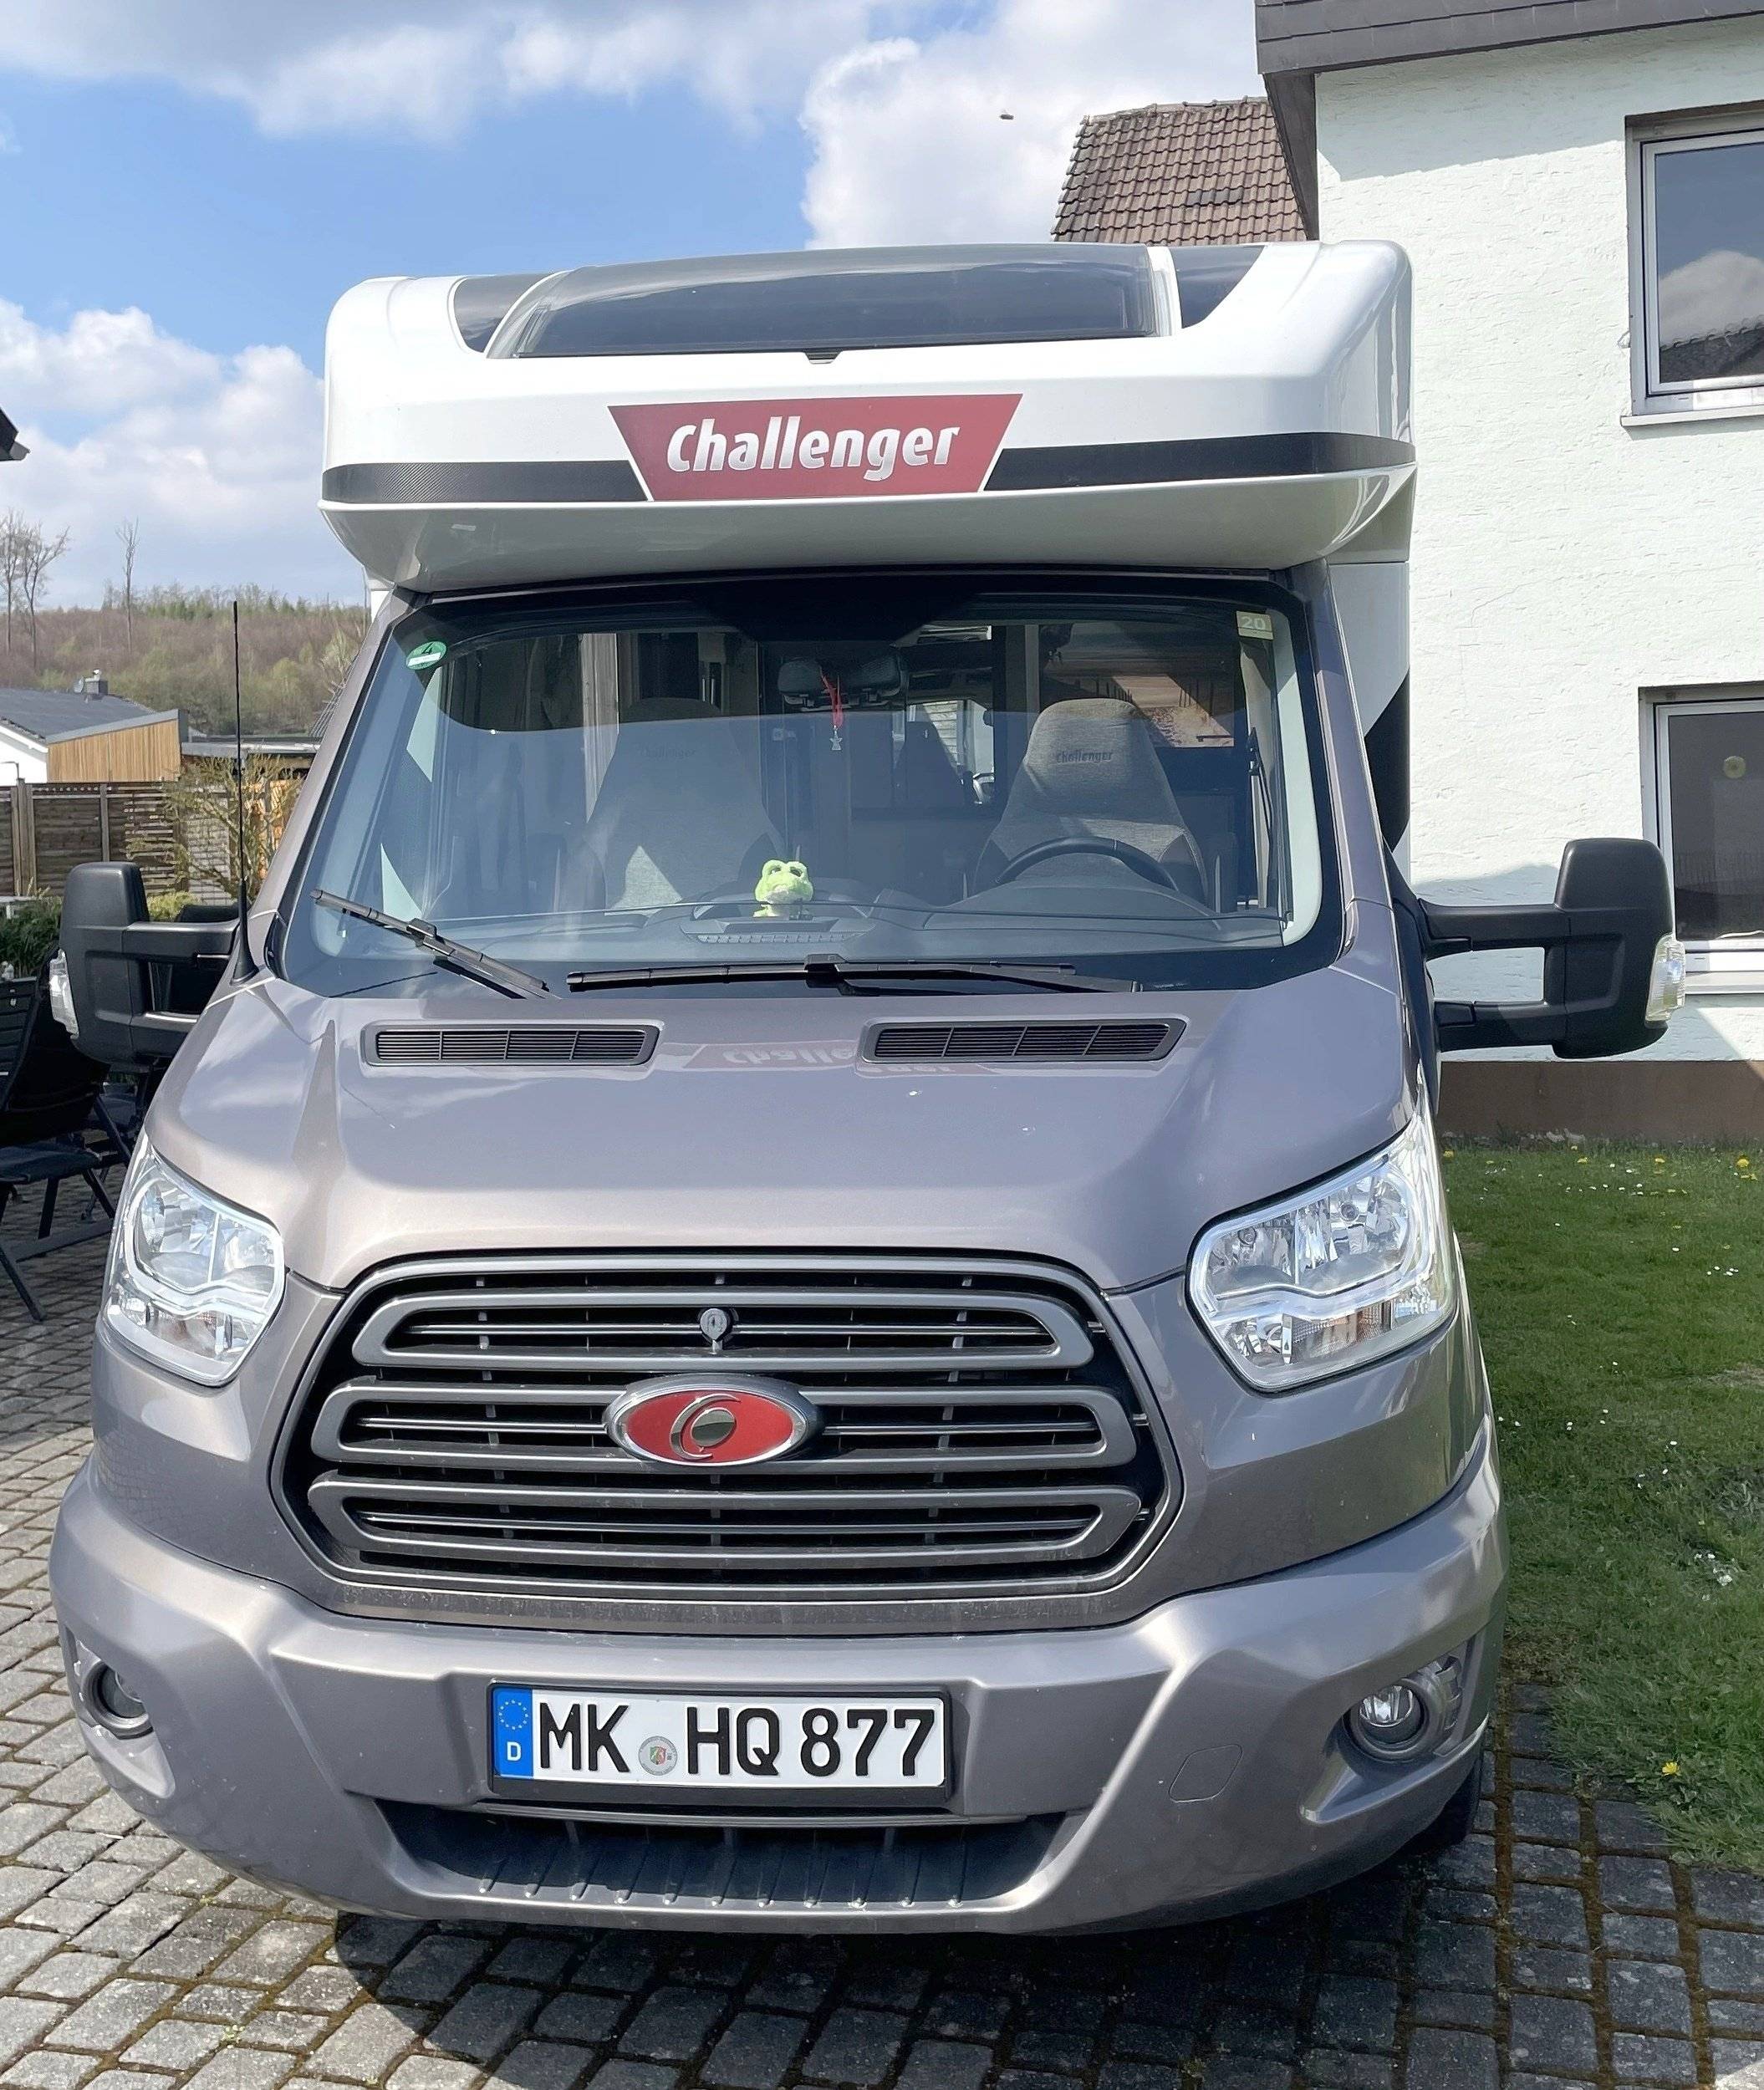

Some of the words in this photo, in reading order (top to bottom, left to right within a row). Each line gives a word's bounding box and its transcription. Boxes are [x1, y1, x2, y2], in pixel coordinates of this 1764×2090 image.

[667, 415, 960, 482] Challenger
[1241, 616, 1266, 630] 20
[421, 642, 435, 655] 4
[539, 1702, 630, 1773] MK
[686, 1706, 781, 1776] HQ
[800, 1707, 936, 1777] 877
[507, 1741, 522, 1761] D
